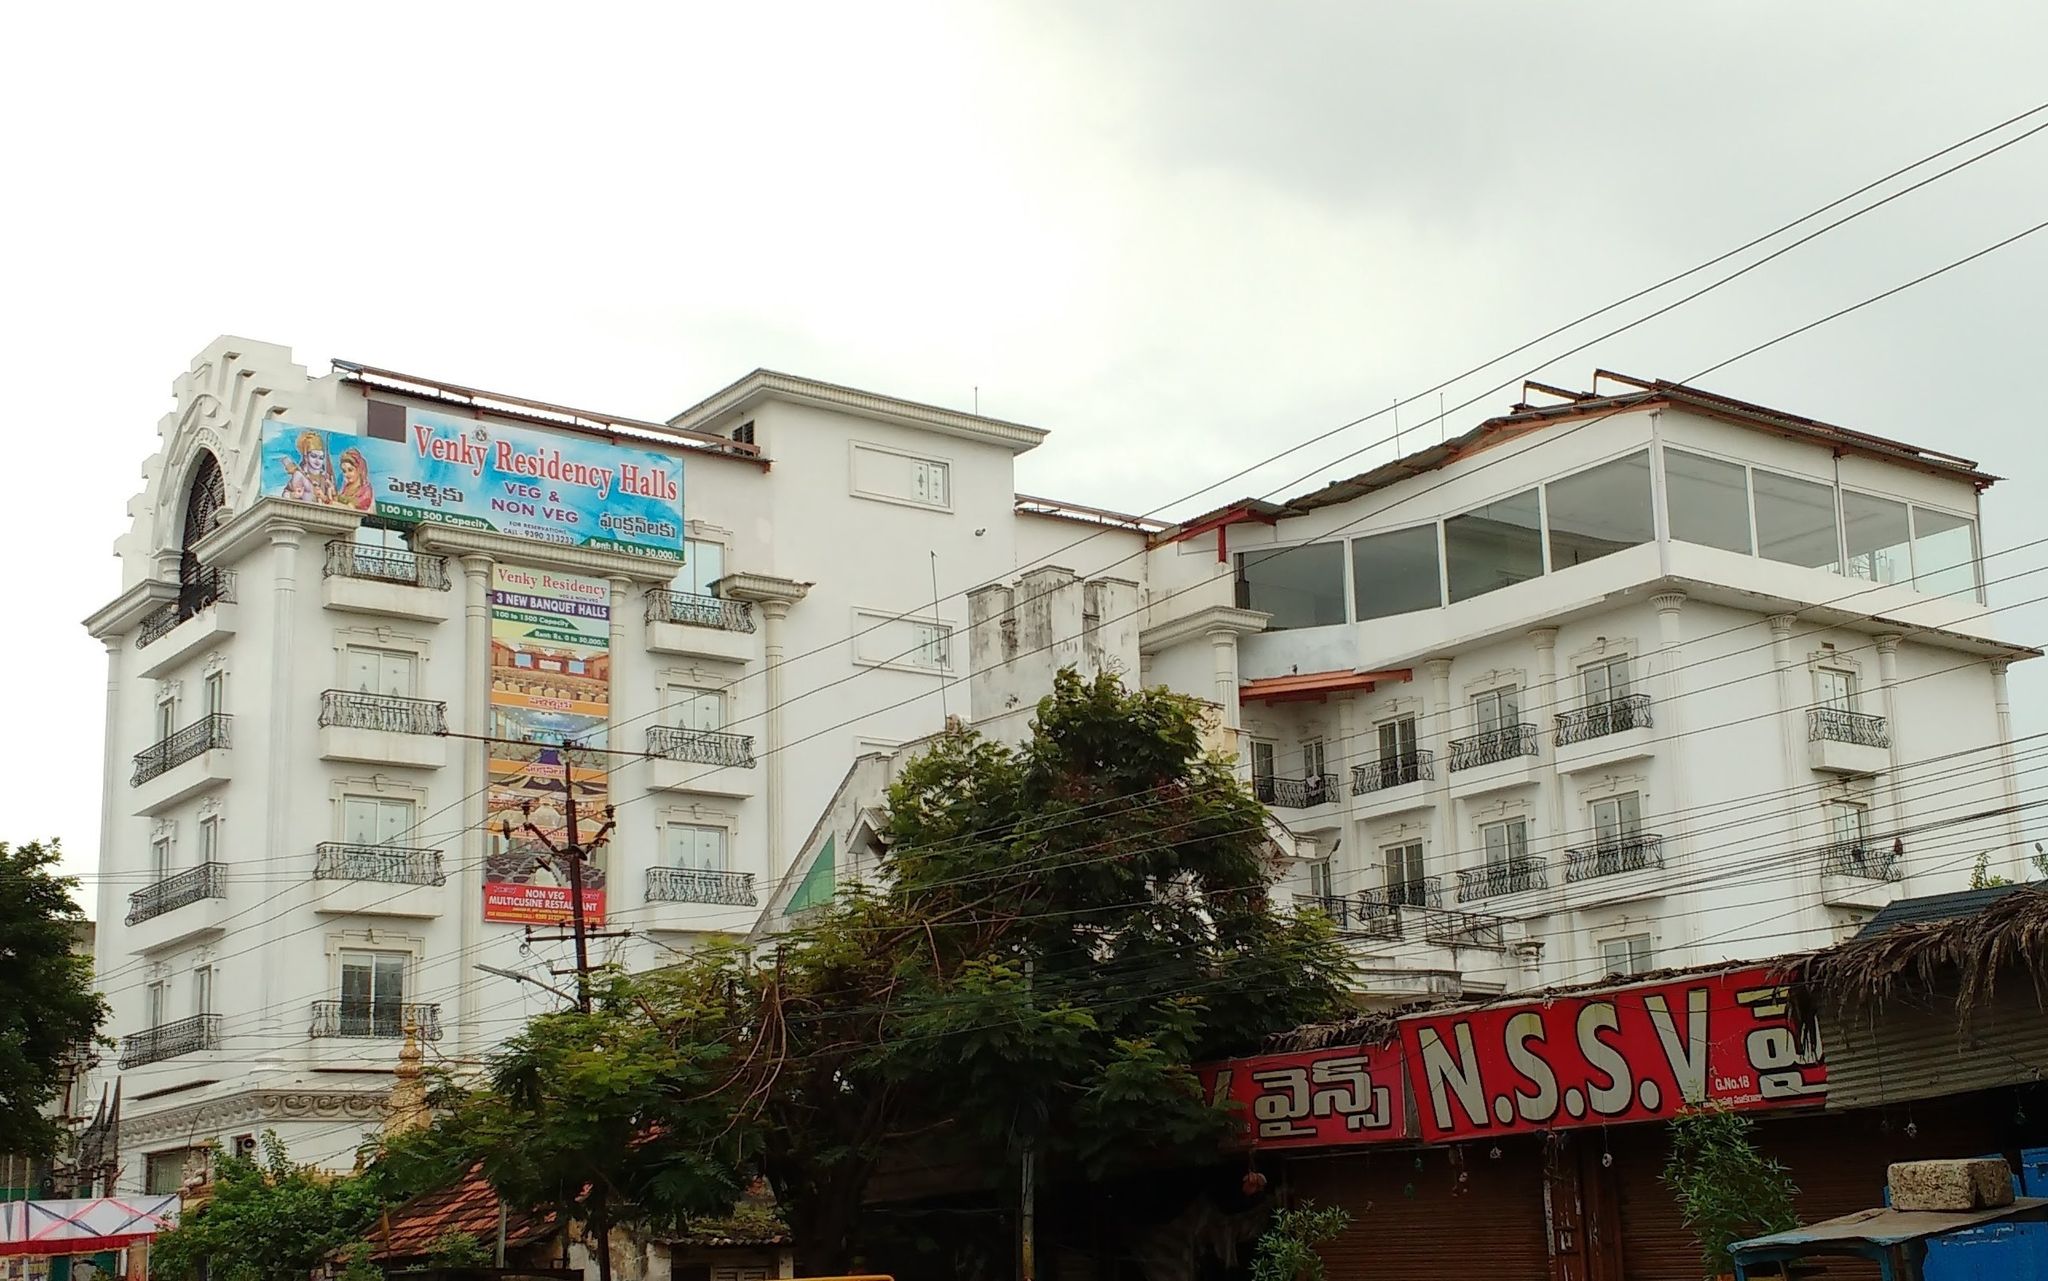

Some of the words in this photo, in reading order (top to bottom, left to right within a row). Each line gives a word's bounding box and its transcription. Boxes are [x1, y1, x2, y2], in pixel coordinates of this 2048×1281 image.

[414, 425, 488, 476] Venky
[495, 441, 613, 498] Residency
[620, 463, 677, 501] Halls
[504, 482, 541, 499] VEG
[548, 490, 560, 503] &
[380, 503, 401, 515] 100
[402, 508, 414, 517] to
[416, 509, 443, 522] 1500
[445, 514, 489, 530] Capacity
[491, 498, 535, 517] NON
[542, 506, 579, 524] VEG
[503, 527, 518, 536] CALL
[634, 547, 644, 556] to
[498, 568, 538, 589] Venky
[542, 575, 608, 599] Residency
[496, 592, 503, 603] 3
[505, 594, 528, 607] NEW
[530, 597, 577, 614] BANQUET
[578, 604, 607, 618] HALLS
[488, 895, 543, 908] MULTICUSINE
[525, 889, 546, 899] NON
[547, 890, 566, 900] VEG
[1418, 988, 1709, 1131] N.S.S.V
[1714, 1075, 1750, 1091] G.No.18
[1252, 1055, 1391, 1139] వైన్స్
